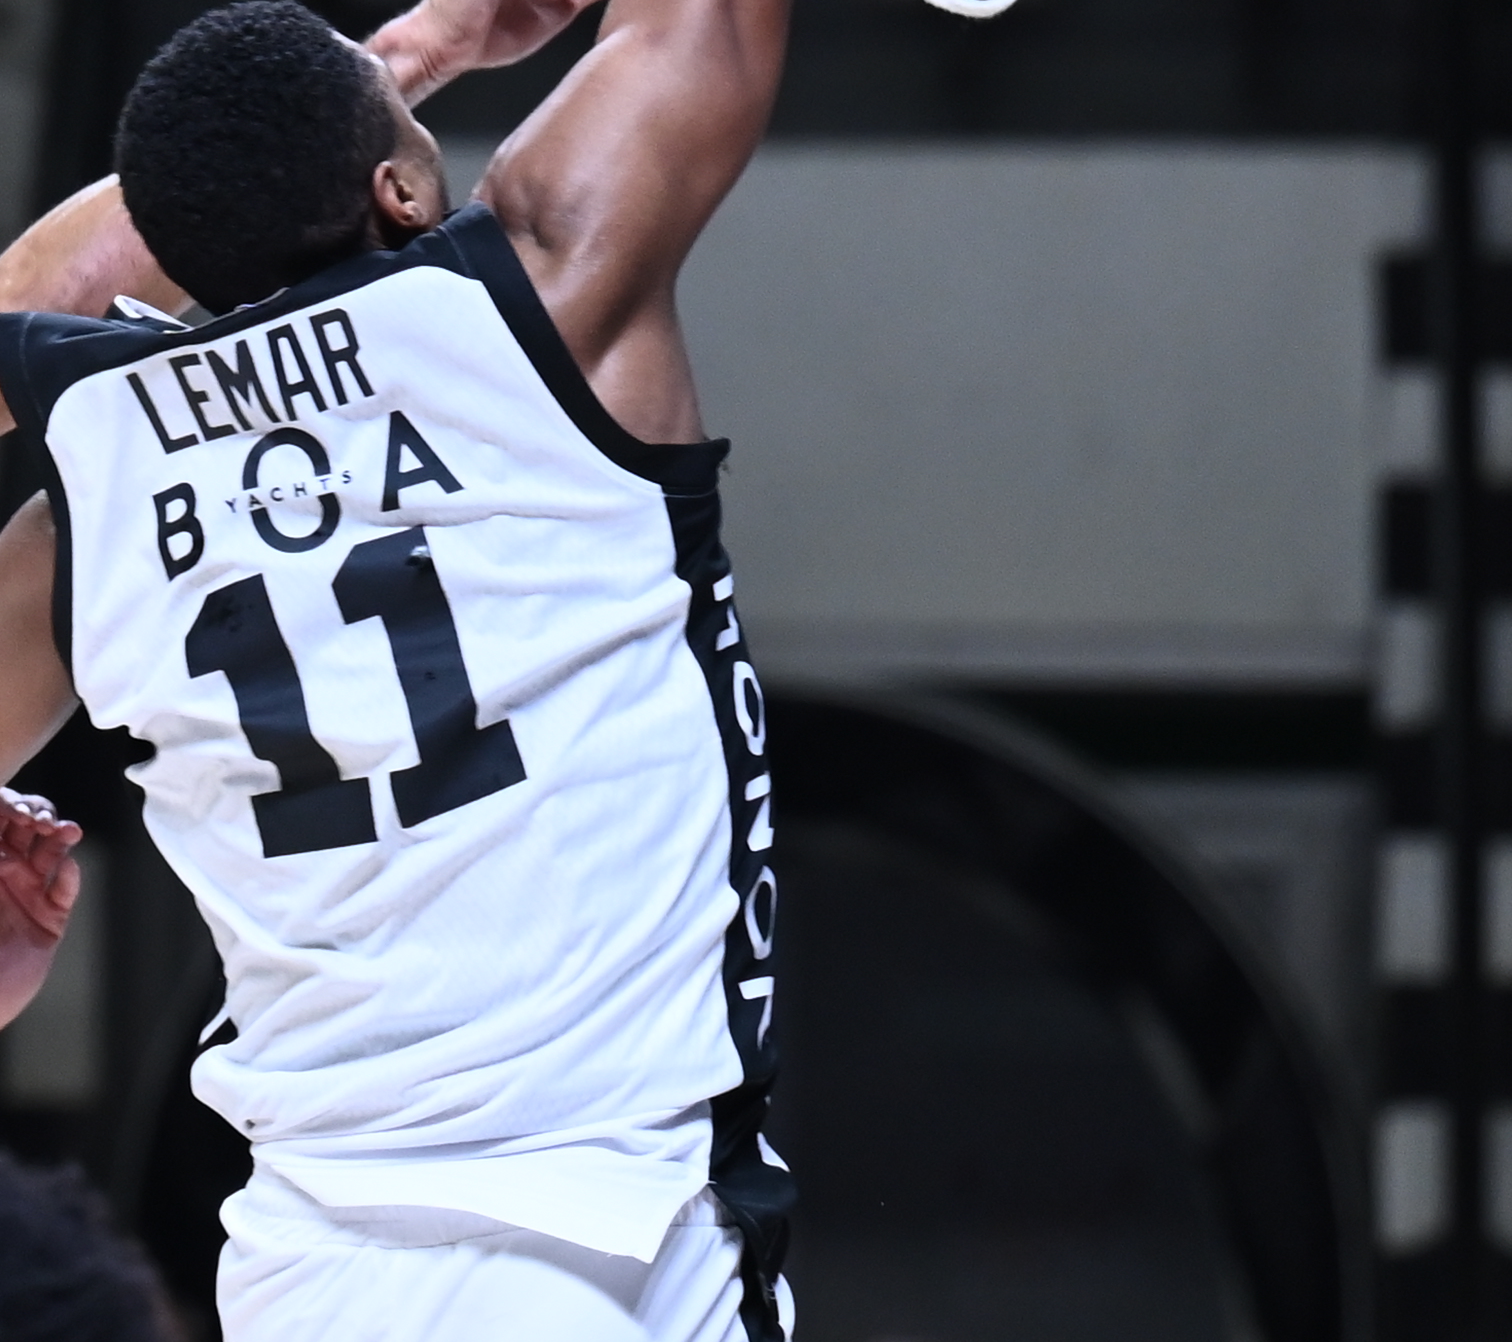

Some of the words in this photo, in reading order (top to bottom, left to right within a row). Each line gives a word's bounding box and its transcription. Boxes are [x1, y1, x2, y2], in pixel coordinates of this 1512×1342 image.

[126, 308, 375, 454] LEMAR
[225, 471, 352, 513] YACHTS
[185, 525, 527, 858] 11
